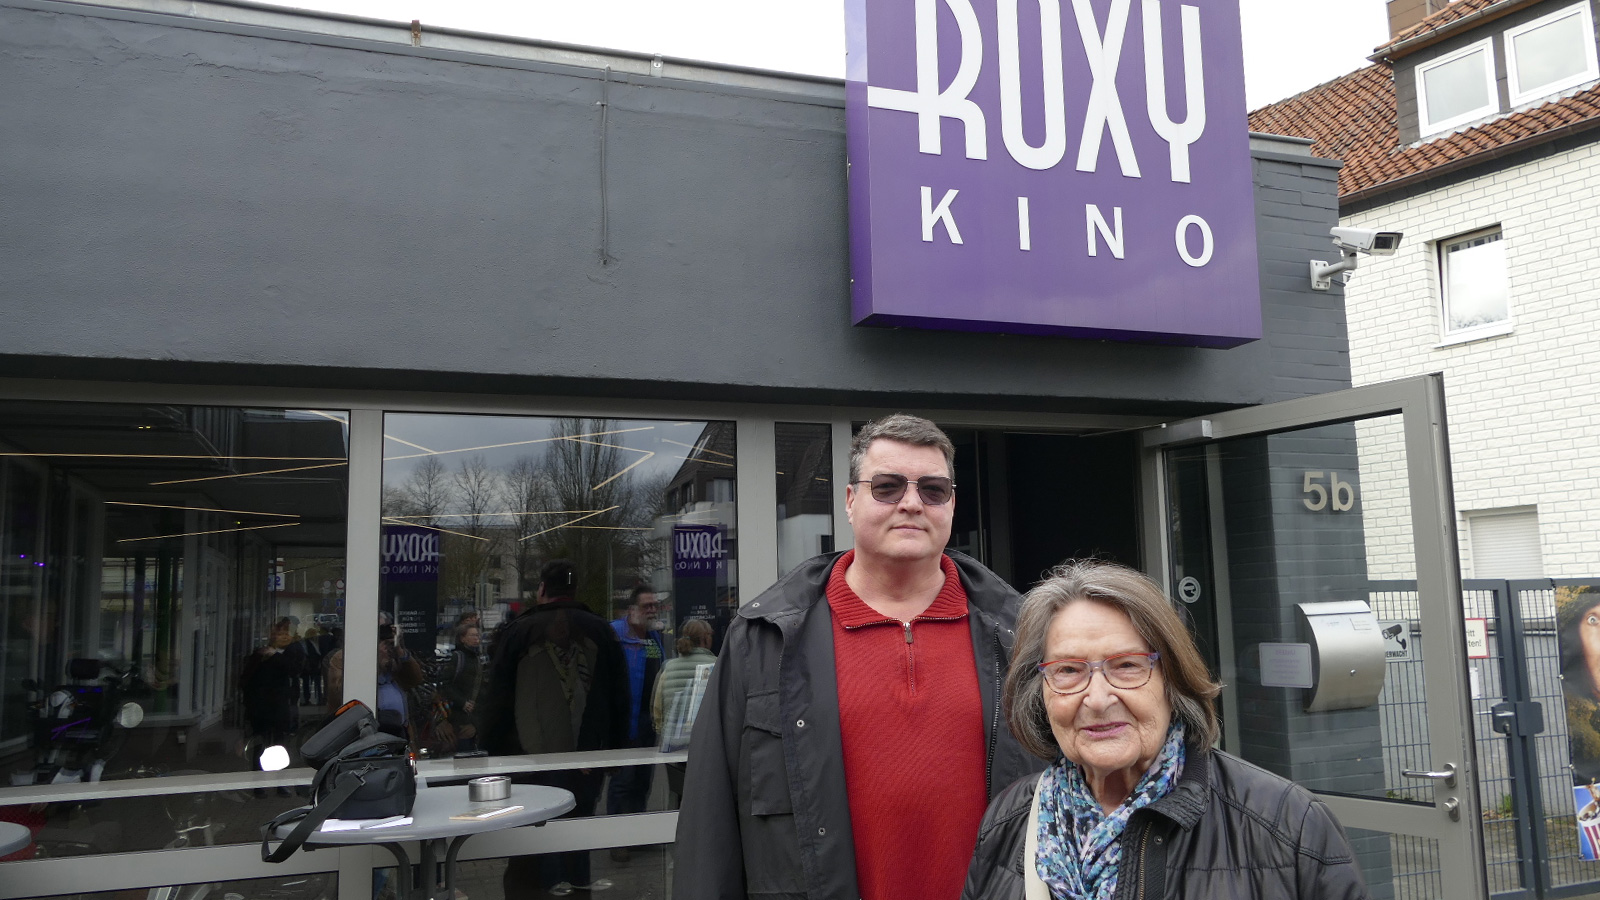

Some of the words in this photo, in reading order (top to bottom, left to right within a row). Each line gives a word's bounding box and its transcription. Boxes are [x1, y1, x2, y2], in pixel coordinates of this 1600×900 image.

[868, 0, 1206, 183] ROXY
[920, 186, 1214, 267] KINO
[1303, 471, 1354, 512] 5b
